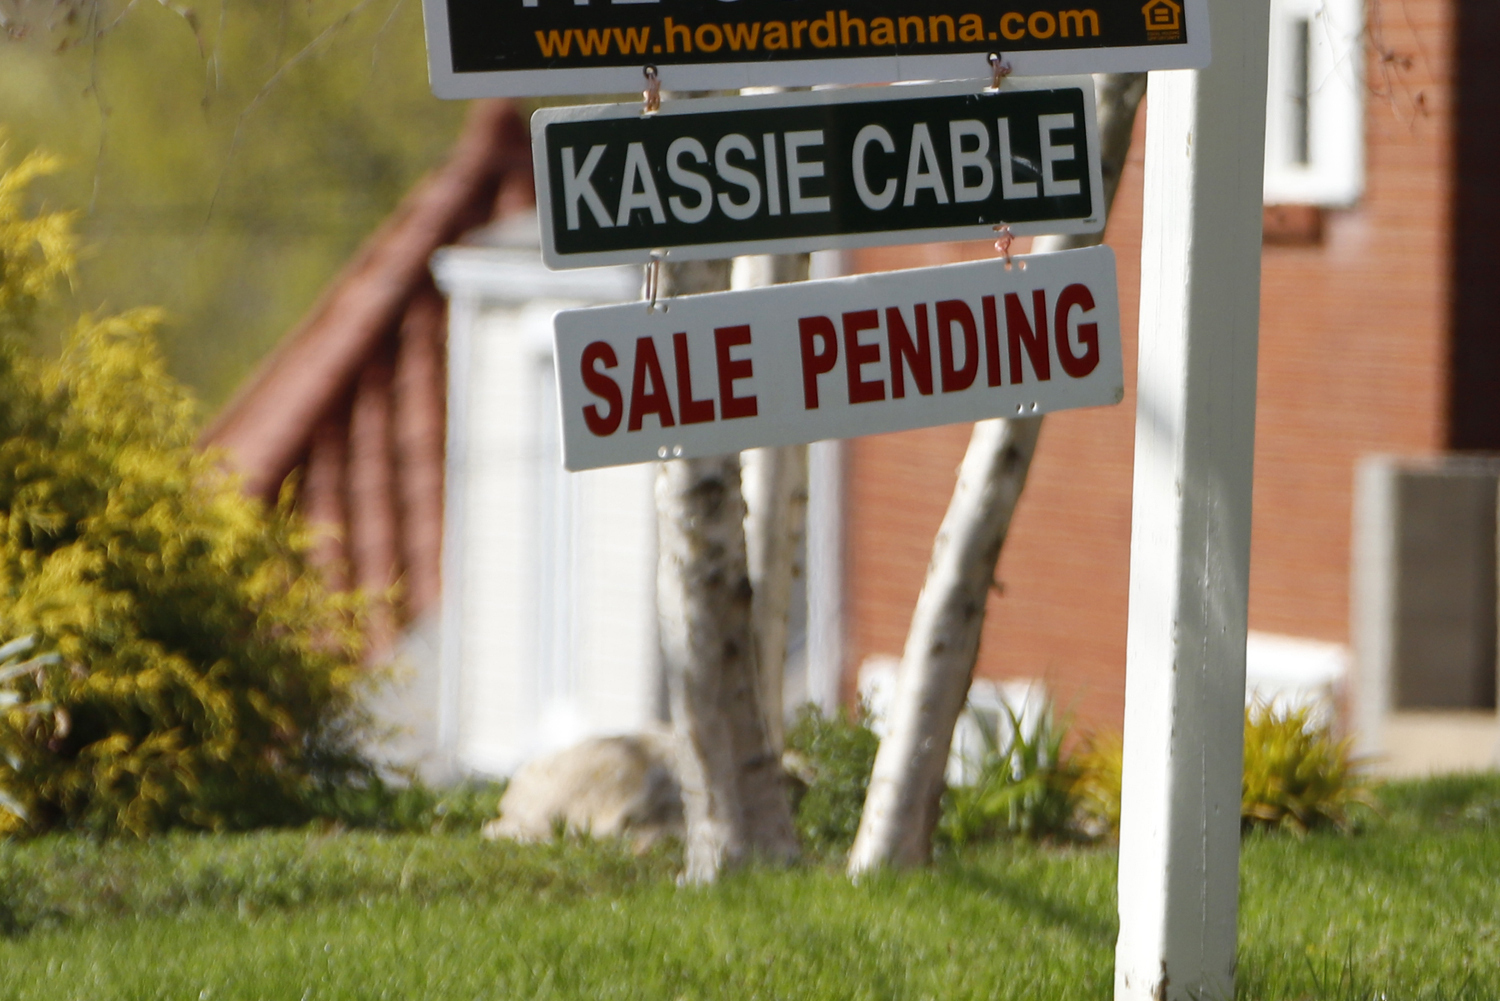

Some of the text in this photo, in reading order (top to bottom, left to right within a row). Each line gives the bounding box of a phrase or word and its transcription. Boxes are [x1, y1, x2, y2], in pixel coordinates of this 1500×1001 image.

[535, 6, 1100, 58] www.howardhanna.com
[561, 112, 1081, 230] KASSIE CABLE
[580, 283, 1100, 438] SALE PENDING
